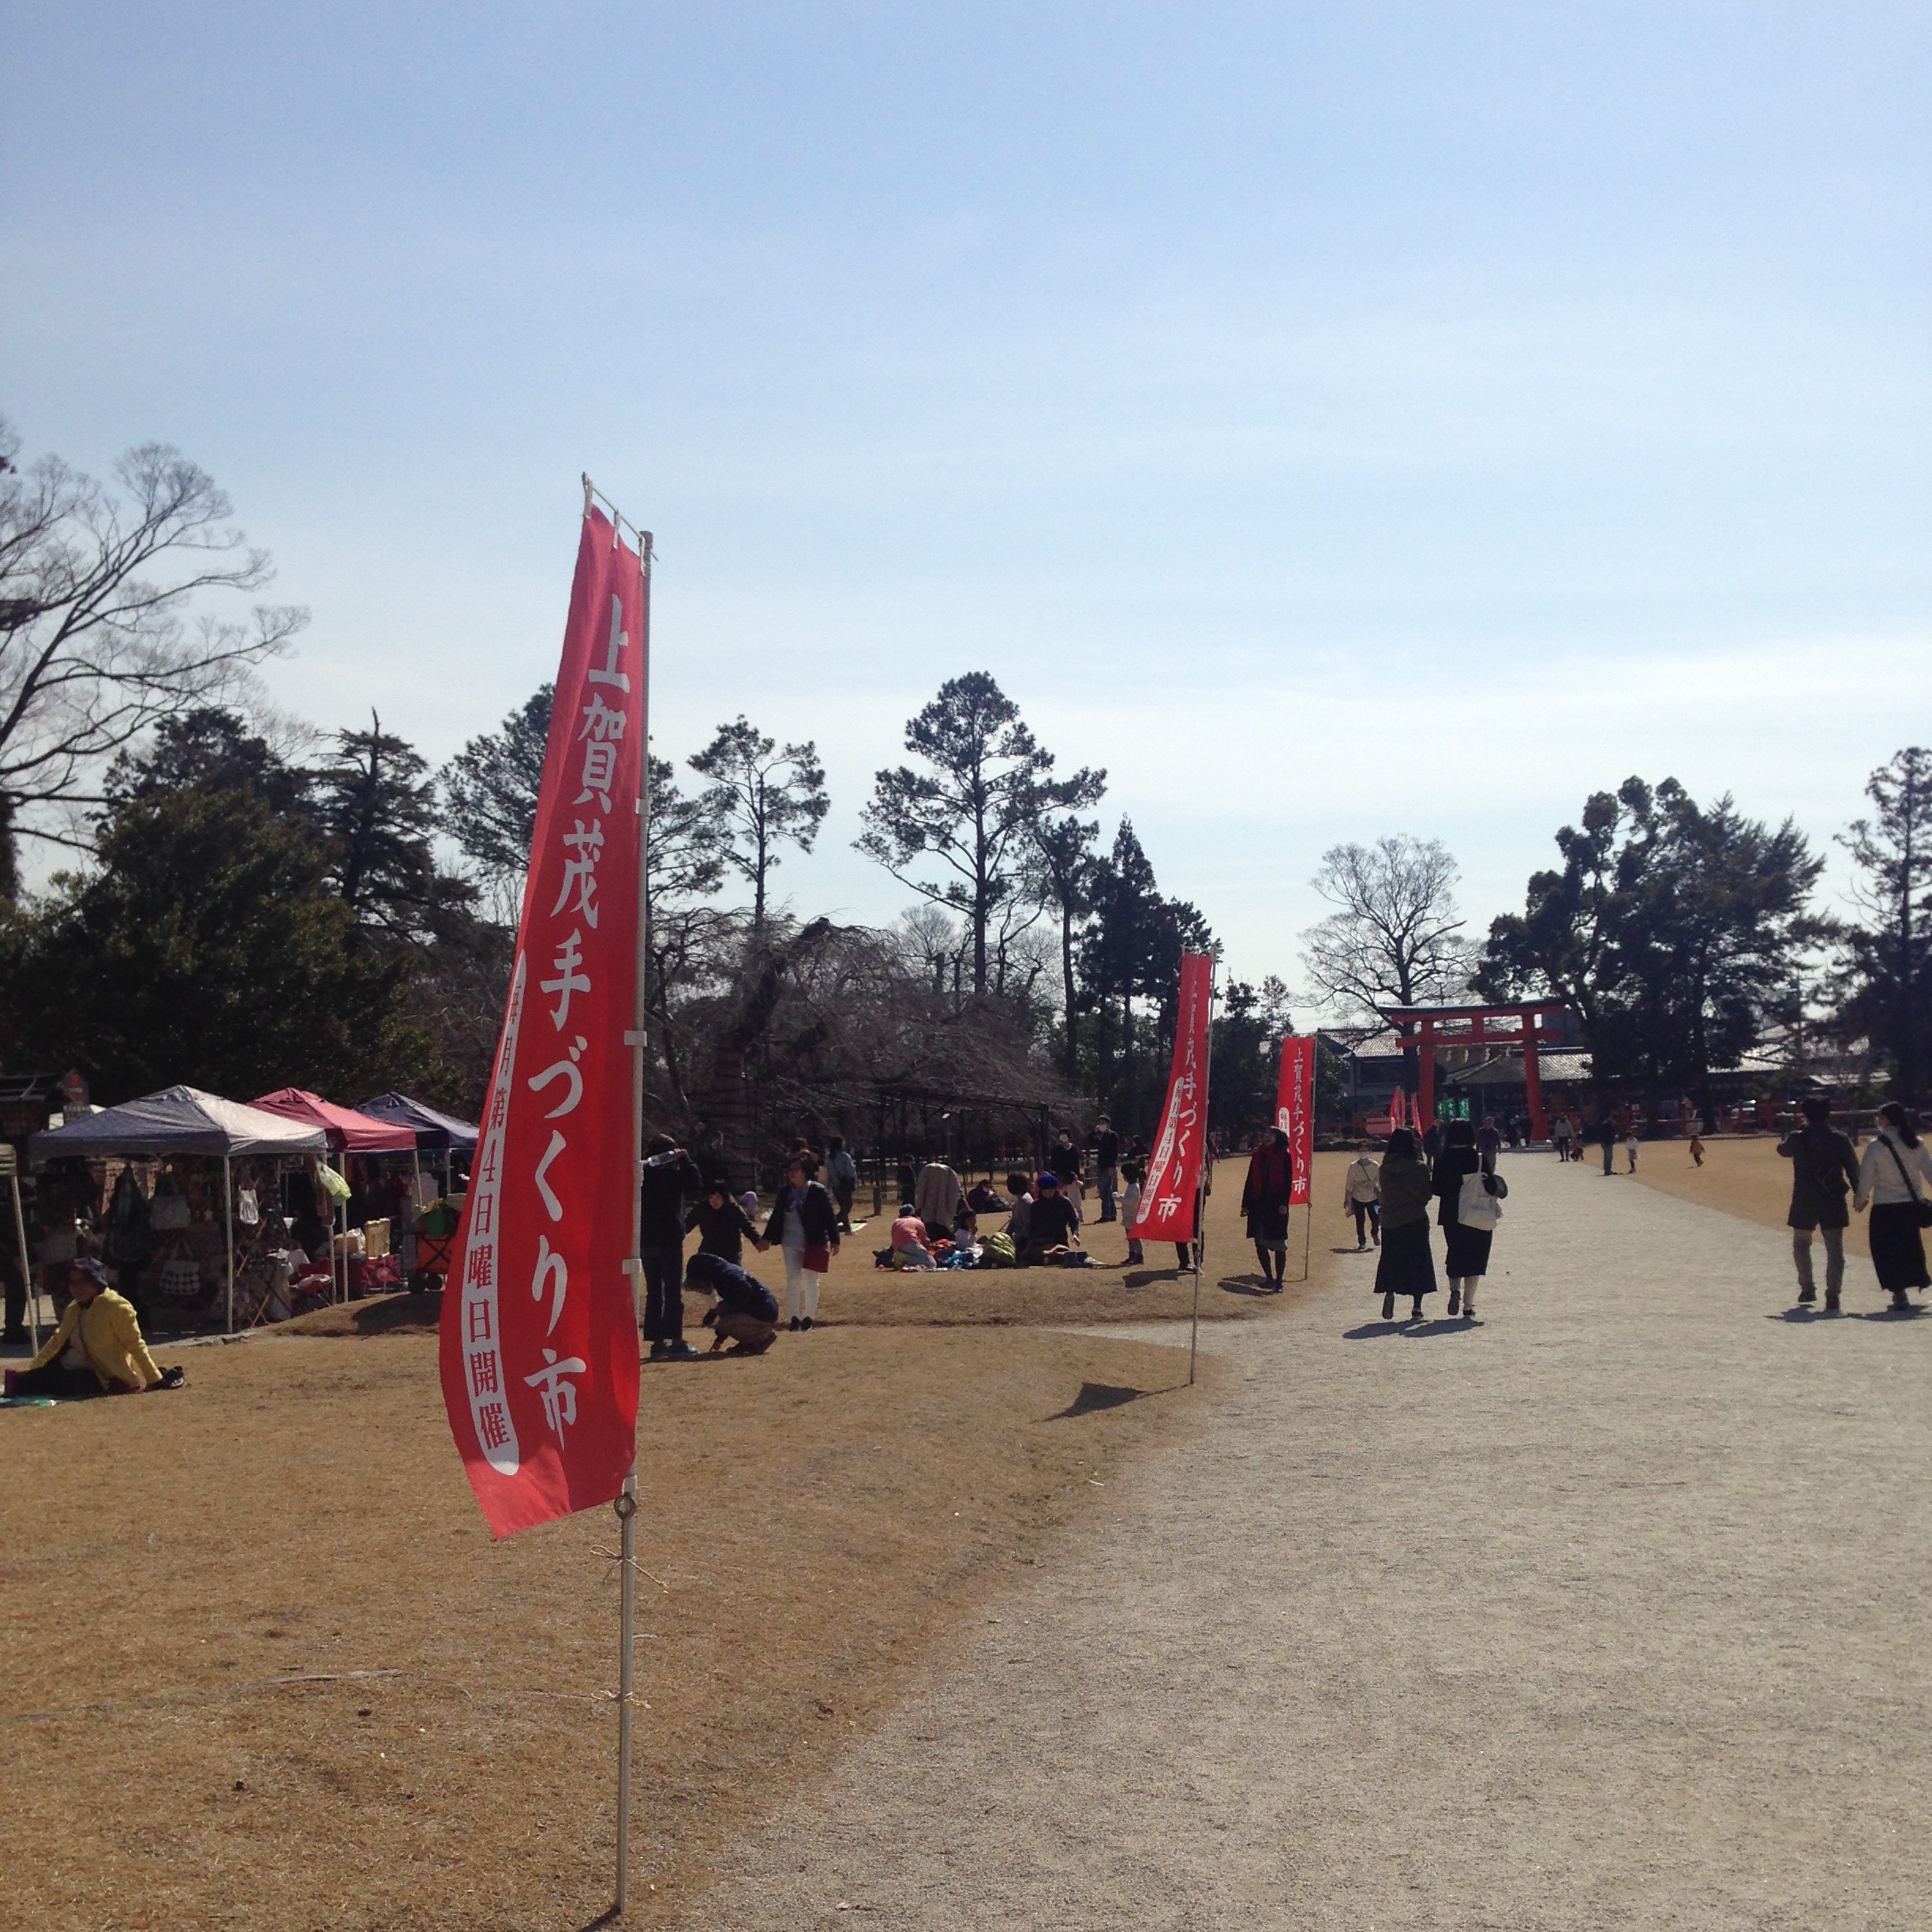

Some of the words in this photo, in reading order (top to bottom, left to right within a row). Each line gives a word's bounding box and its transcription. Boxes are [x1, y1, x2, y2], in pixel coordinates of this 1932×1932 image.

[524, 594, 631, 1451] 上賀茂手づくり市
[1292, 1047, 1307, 1195] 上賀茂手づくり市
